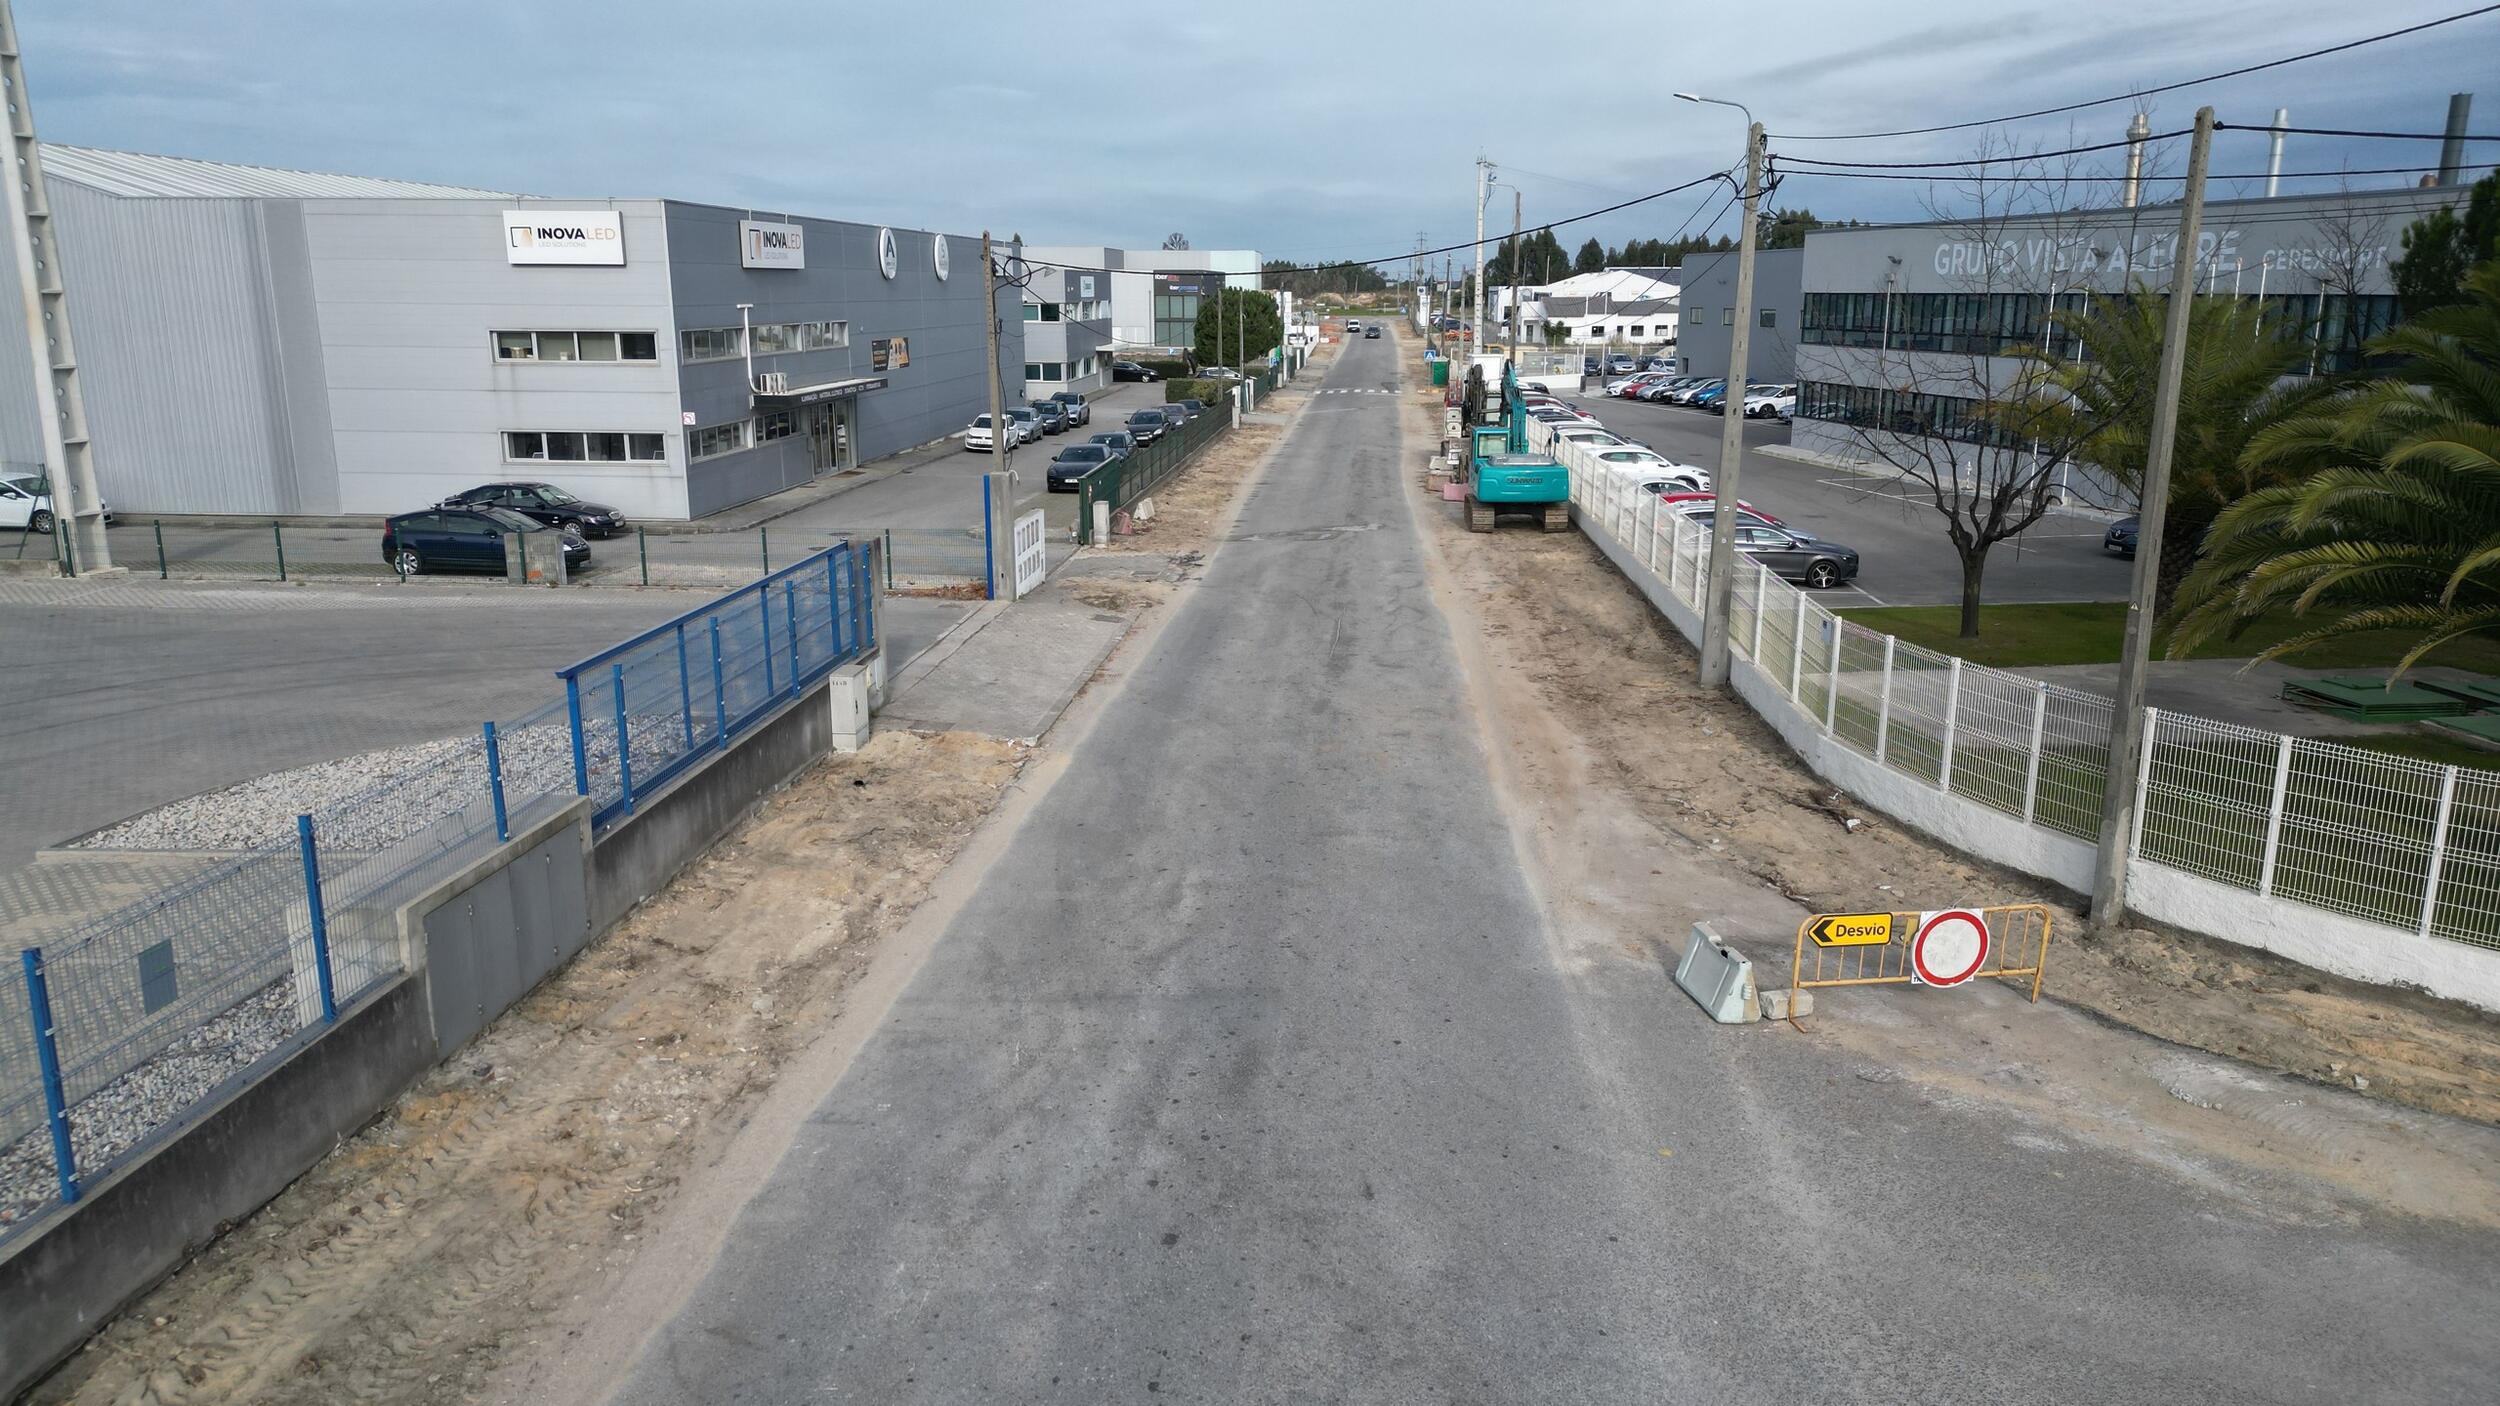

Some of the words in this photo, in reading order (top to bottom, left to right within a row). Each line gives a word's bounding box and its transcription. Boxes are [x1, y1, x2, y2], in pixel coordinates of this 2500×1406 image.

[537, 227, 616, 240] INOVALED
[763, 231, 801, 250] INOVALED
[2027, 237, 2098, 273] VISTA
[1836, 923, 1886, 937] Desvio
